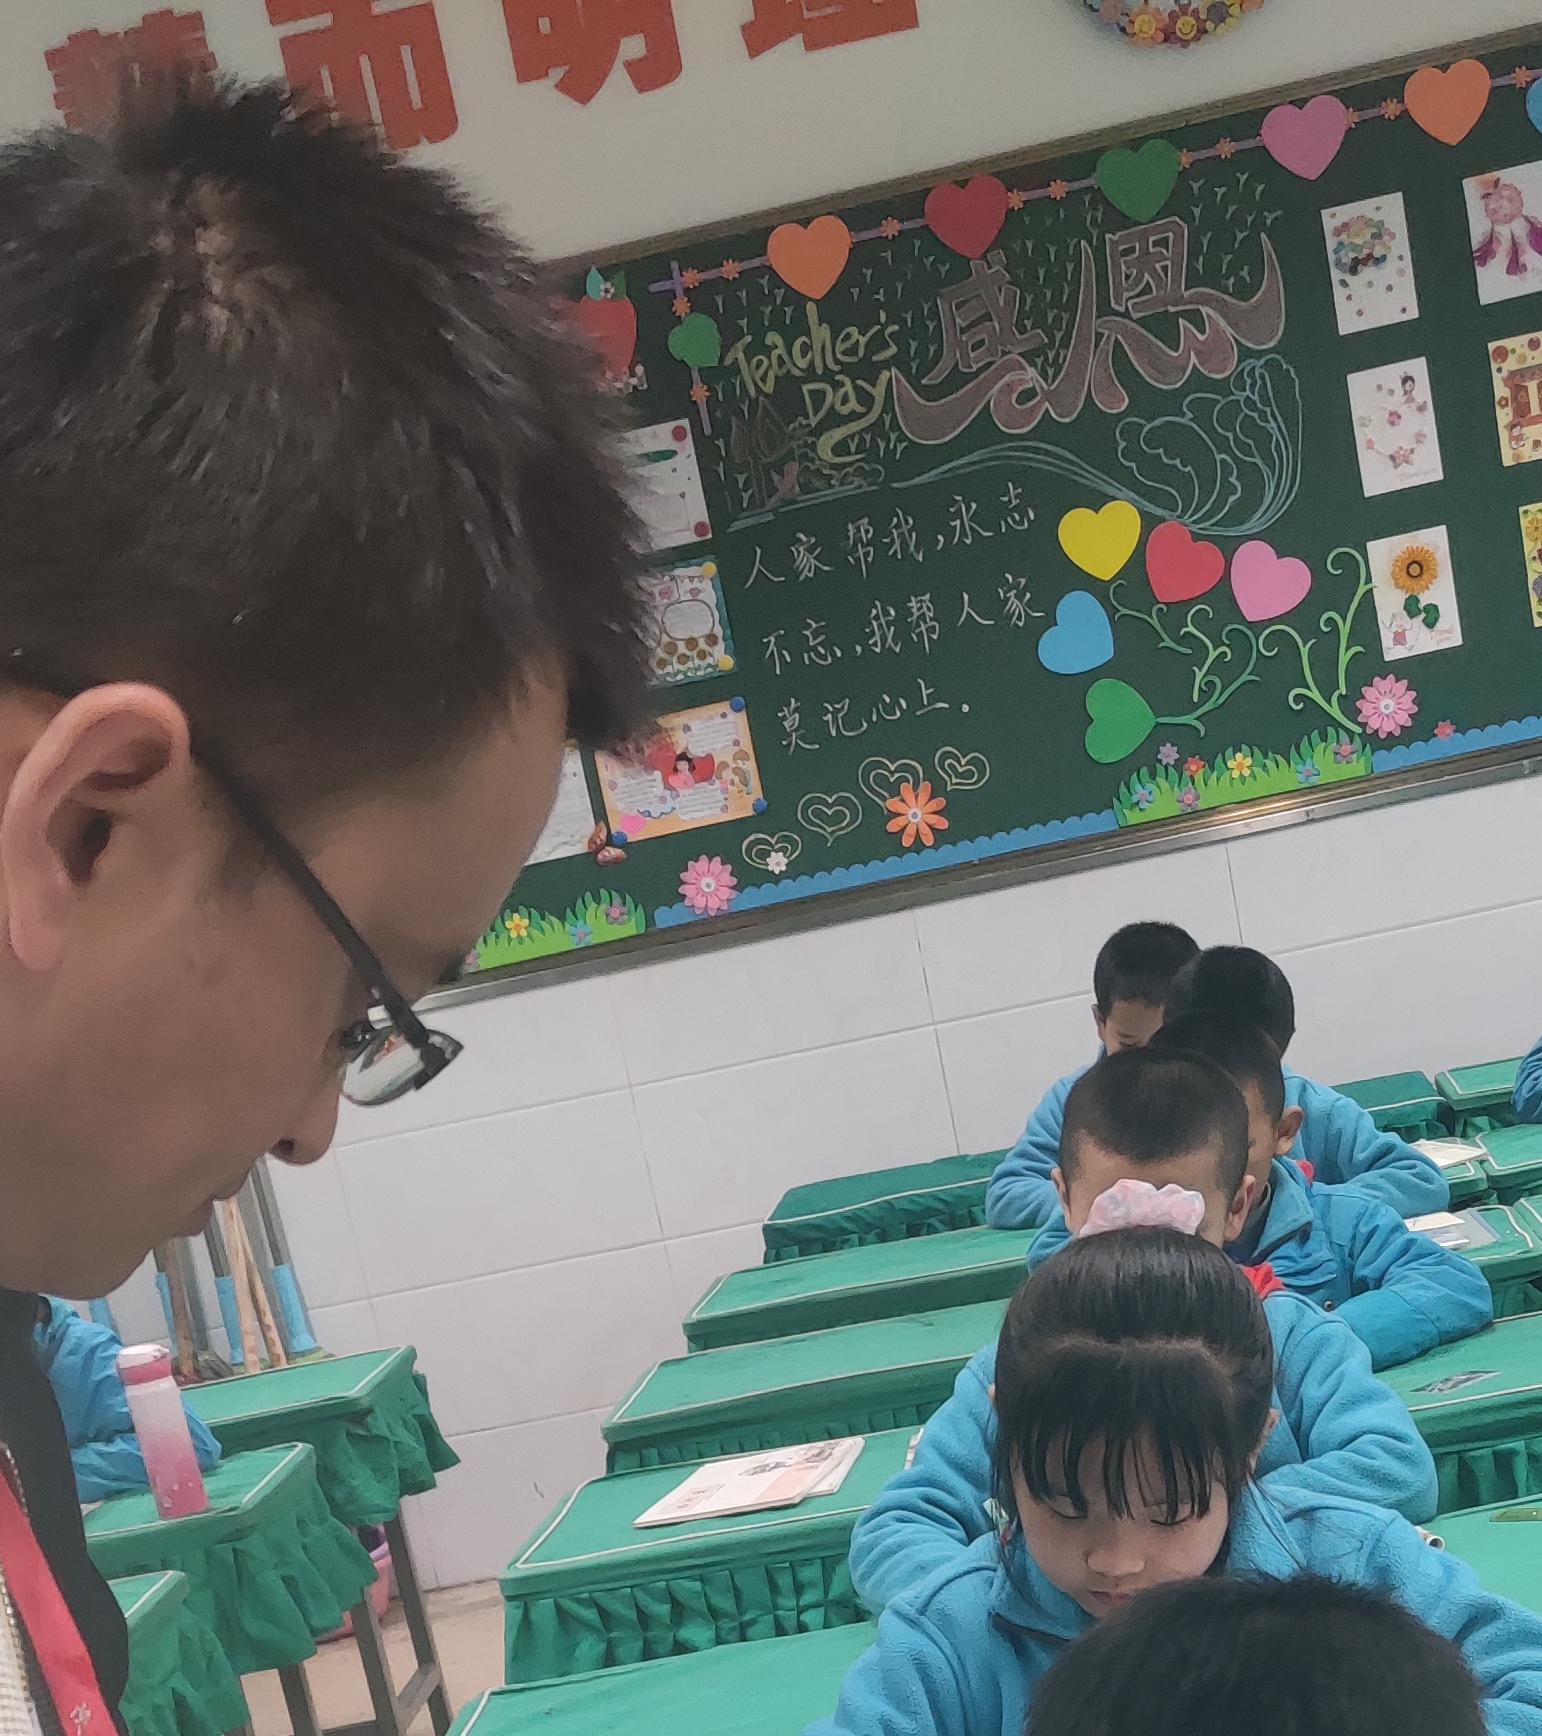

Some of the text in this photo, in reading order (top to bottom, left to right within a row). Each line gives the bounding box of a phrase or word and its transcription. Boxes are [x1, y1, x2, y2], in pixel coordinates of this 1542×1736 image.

[723, 301, 900, 399] Teacher's
[891, 216, 1285, 444] 感恩
[801, 370, 891, 464] Day
